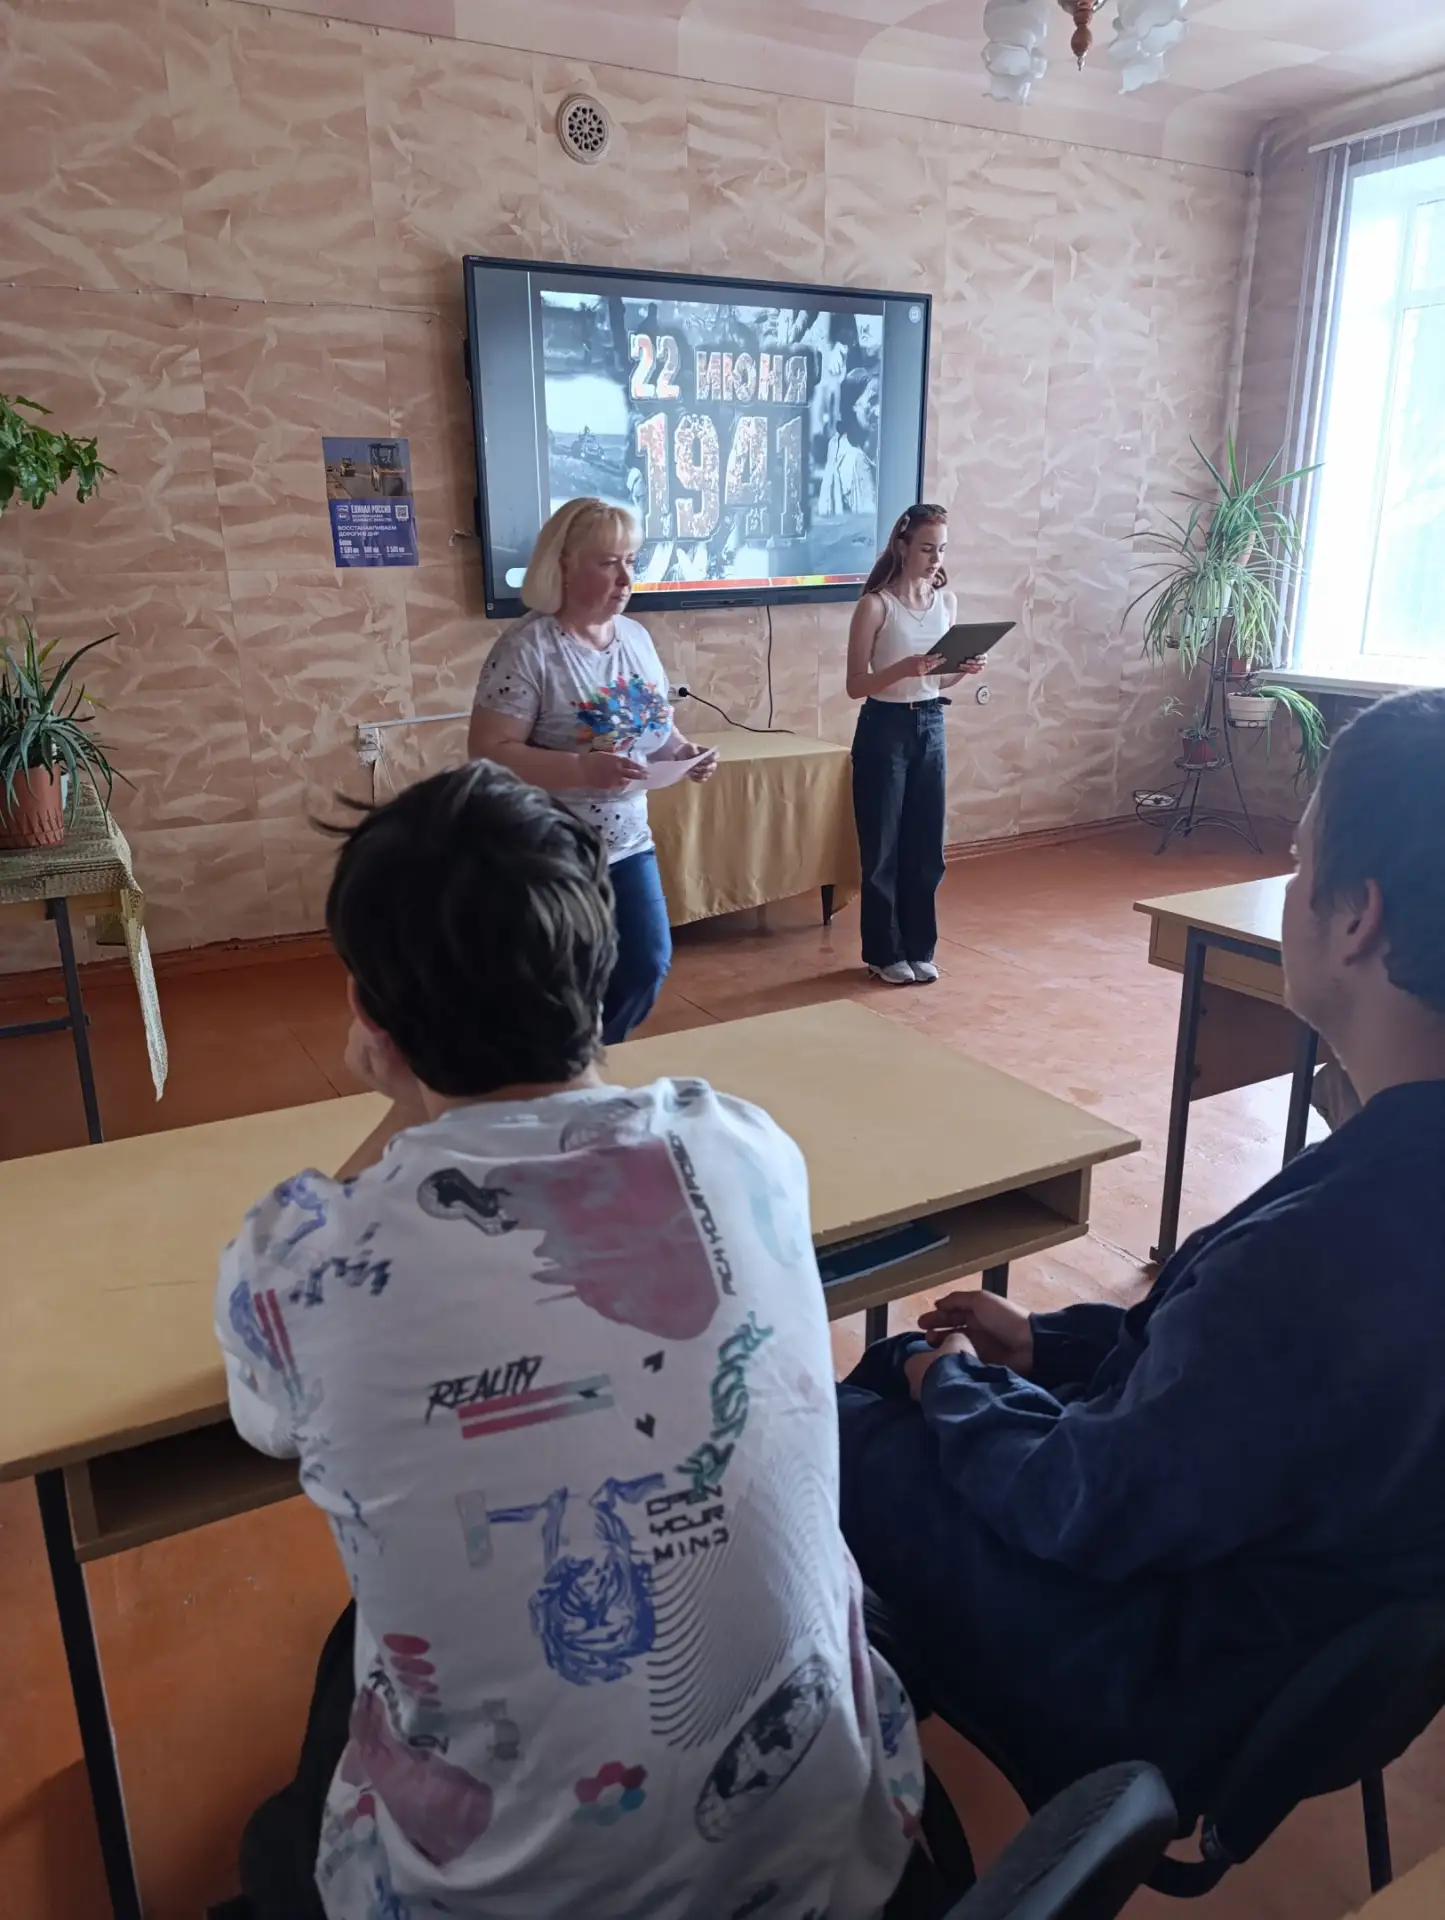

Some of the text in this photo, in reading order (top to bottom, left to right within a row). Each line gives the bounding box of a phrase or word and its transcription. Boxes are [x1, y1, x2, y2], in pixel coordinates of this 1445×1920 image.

[629, 333, 808, 403] 22 ИЮНЯ
[637, 412, 805, 538] 1941
[425, 1355, 543, 1425] REALITY
[649, 1504, 724, 1537] YOUR
[653, 1527, 729, 1565] MIND
